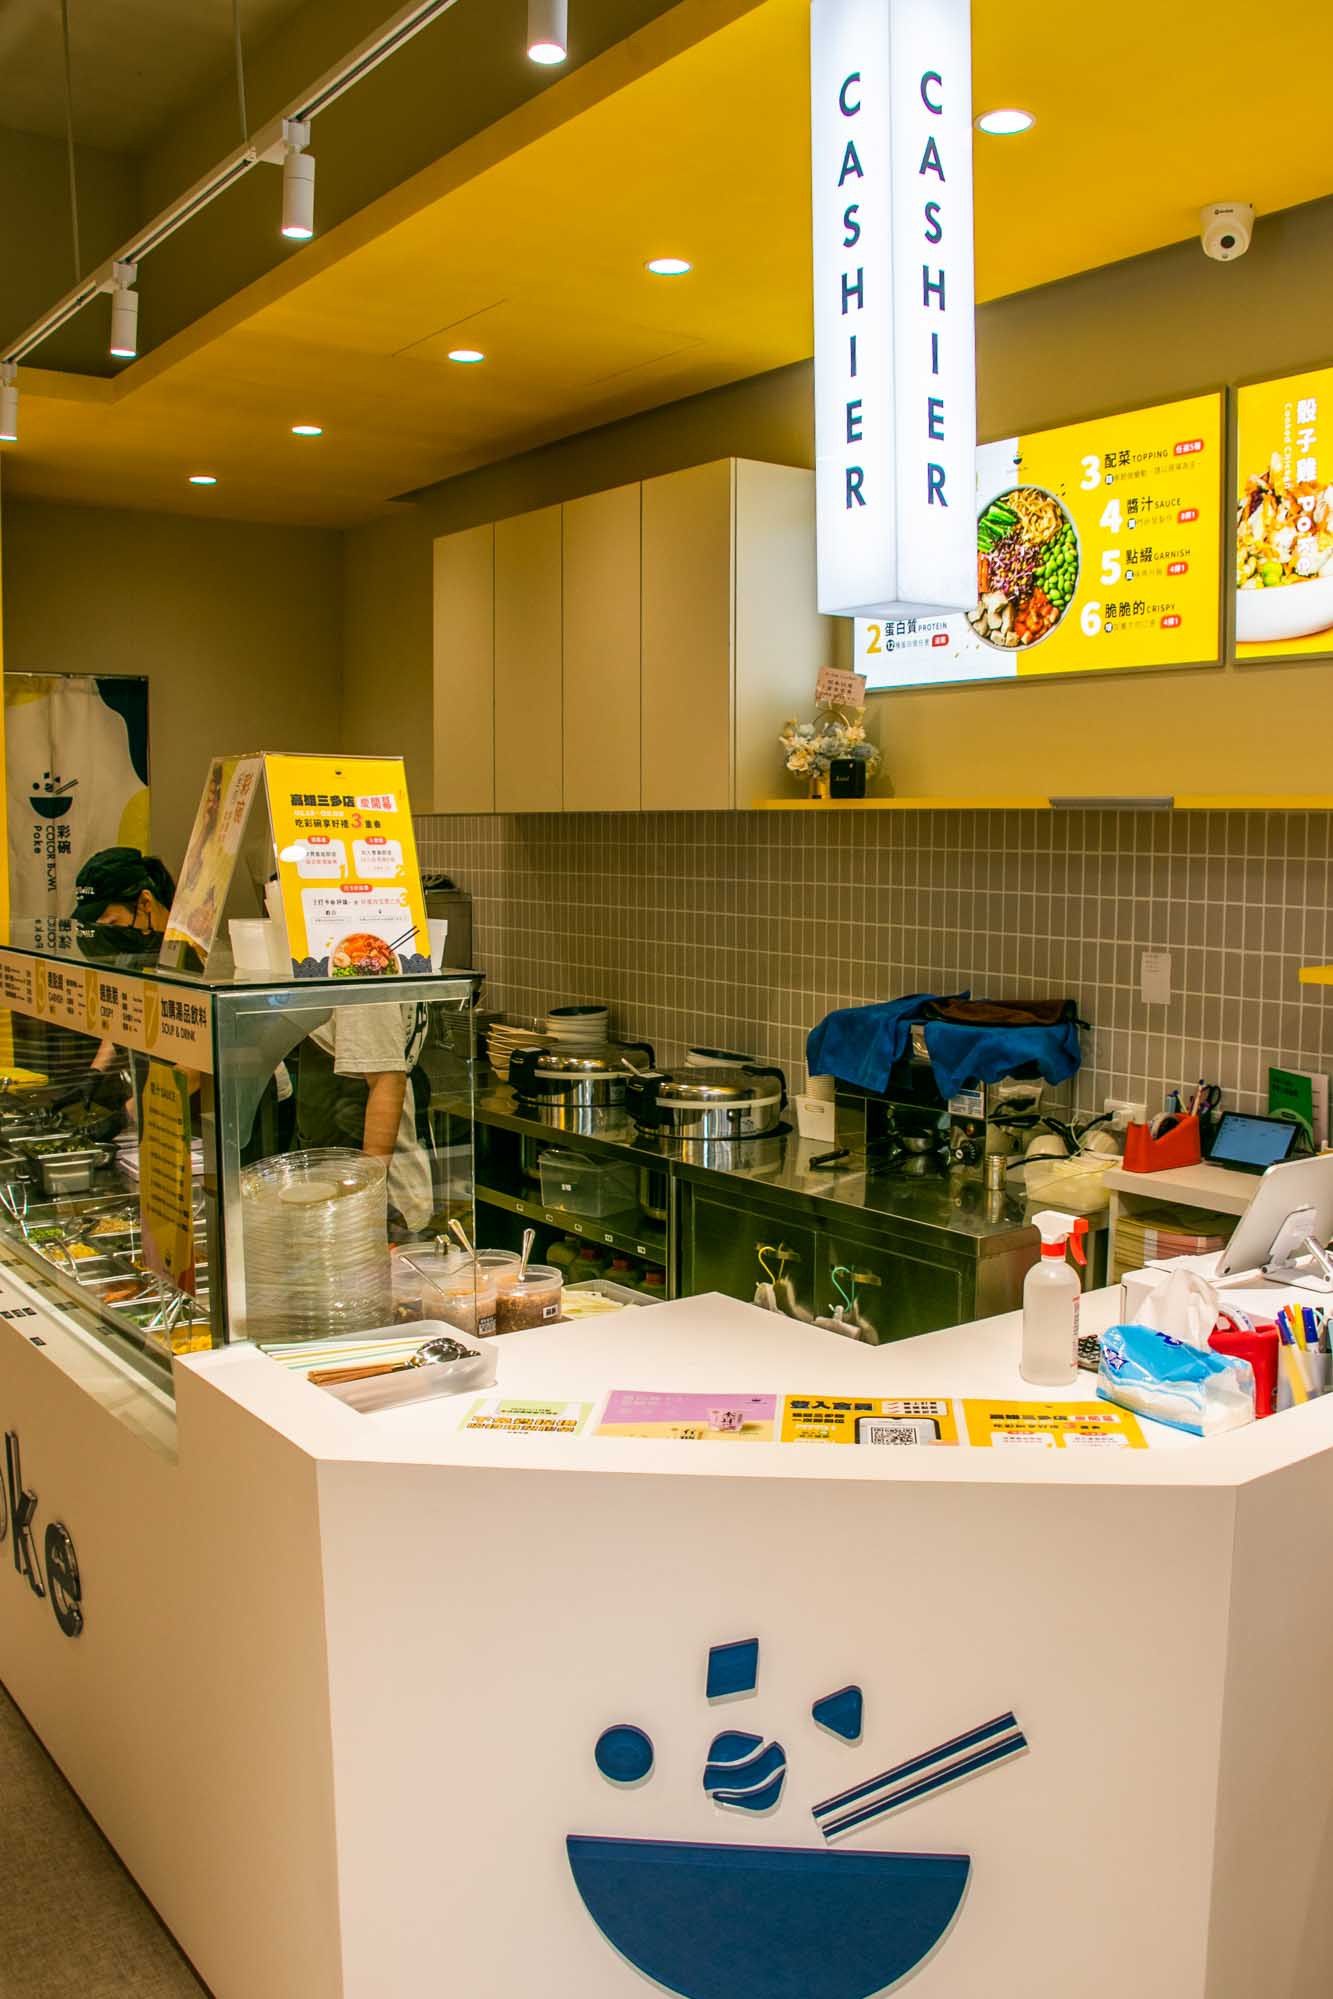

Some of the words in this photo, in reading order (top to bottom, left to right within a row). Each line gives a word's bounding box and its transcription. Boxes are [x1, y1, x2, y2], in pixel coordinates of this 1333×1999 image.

[838, 71, 867, 510] CASHIER
[917, 70, 949, 508] CASHIER
[1080, 454, 1101, 490] 3
[1104, 450, 1131, 469] 配菜
[1132, 449, 1169, 462] TOPPING
[1100, 499, 1123, 534] 4
[1127, 496, 1153, 514] 醬汁
[1154, 498, 1182, 510] SAUCE
[1296, 495, 1317, 576] Poke
[1100, 549, 1122, 585] 5
[1126, 547, 1153, 565] 點綴
[1154, 548, 1191, 561] GARNISH
[866, 623, 882, 654] 2
[884, 618, 917, 637] 蛋白質
[918, 621, 948, 632] PROTEIN
[1080, 601, 1102, 637] 6
[1105, 600, 1145, 618] 脆脆的
[1146, 602, 1176, 614] CRISPY
[33, 825, 44, 854] Poke
[351, 812, 362, 829] 3
[46, 825, 56, 859] COLOR
[161, 1021, 175, 1035] SOUP
[0, 1430, 84, 1637] ke
